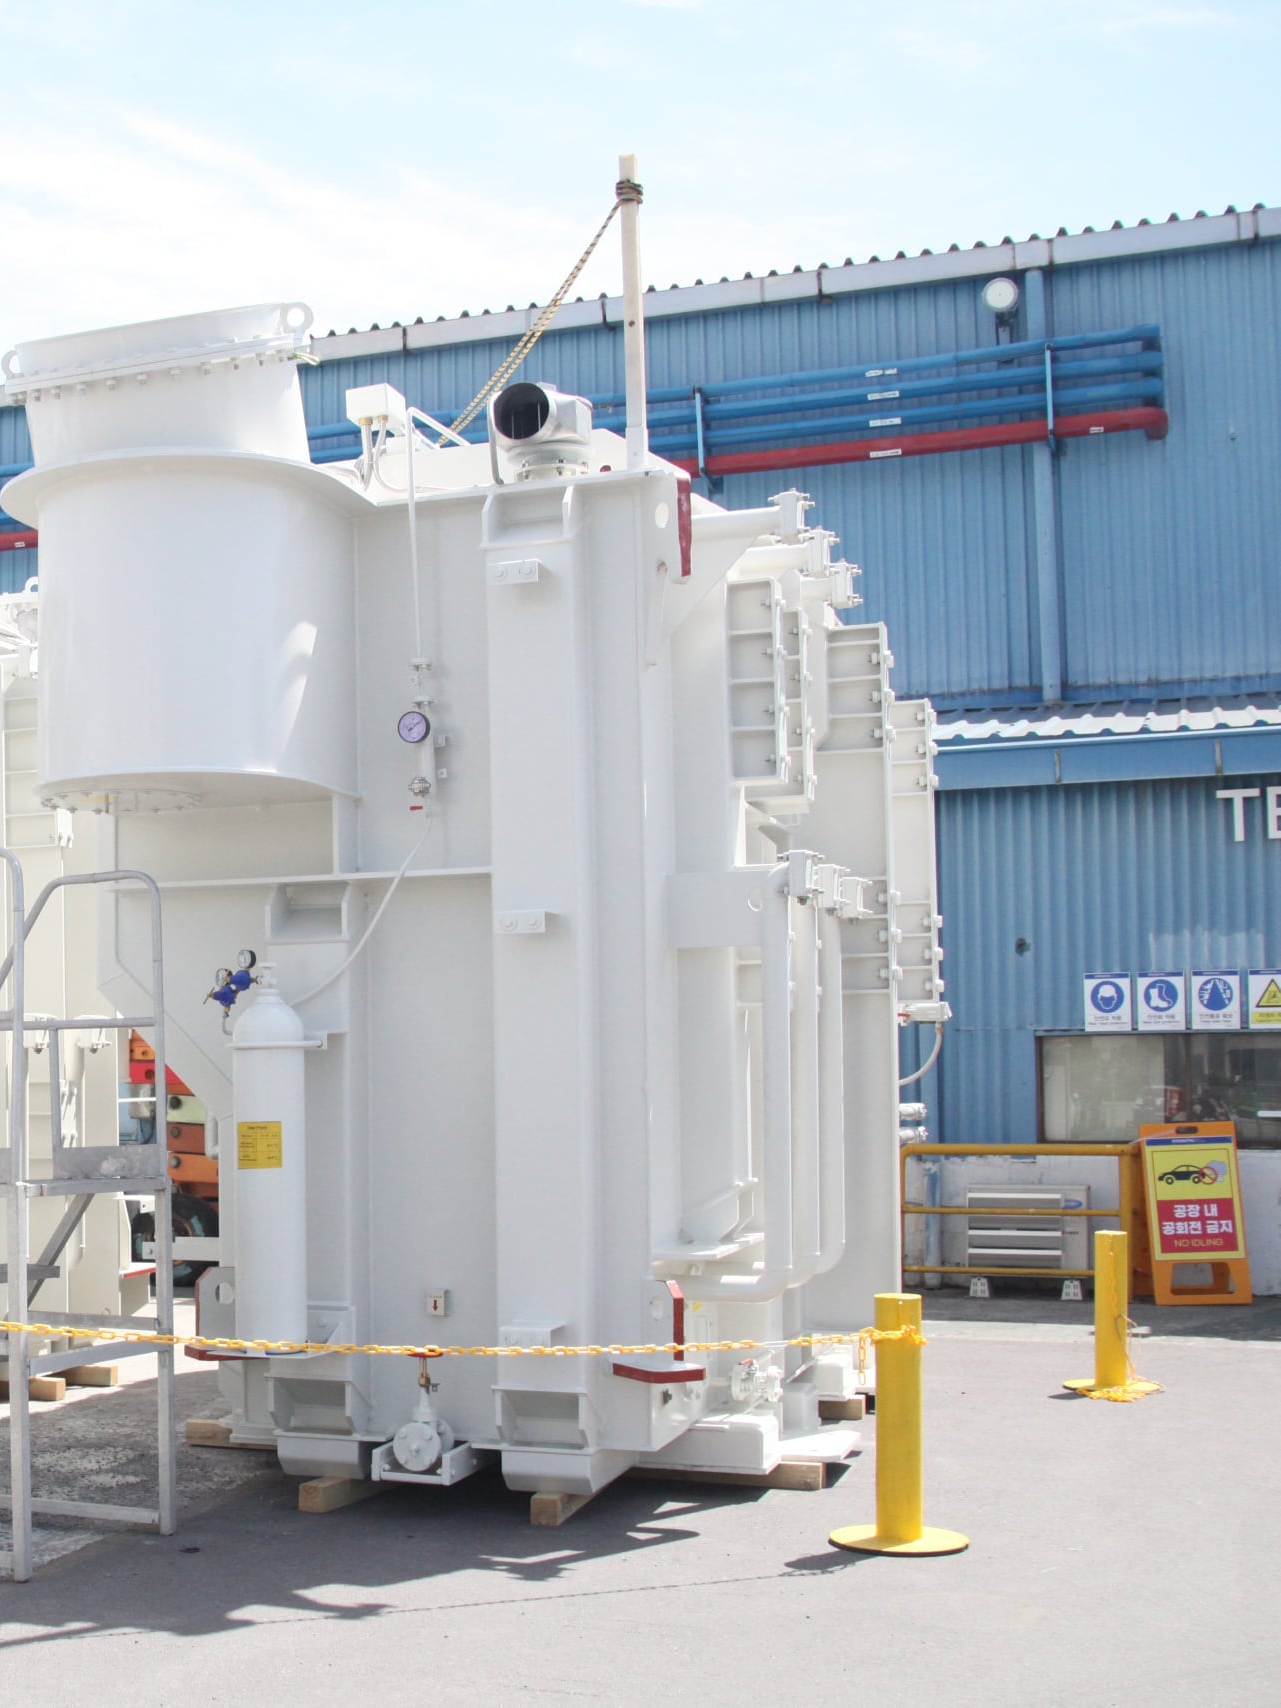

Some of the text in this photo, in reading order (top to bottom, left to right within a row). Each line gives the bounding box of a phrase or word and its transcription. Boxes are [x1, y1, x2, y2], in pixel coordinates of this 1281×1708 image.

[1174, 1203, 1218, 1217] 공장 내
[1162, 1220, 1232, 1235] 공회전 금지
[1174, 1238, 1223, 1248] NO IDLING
